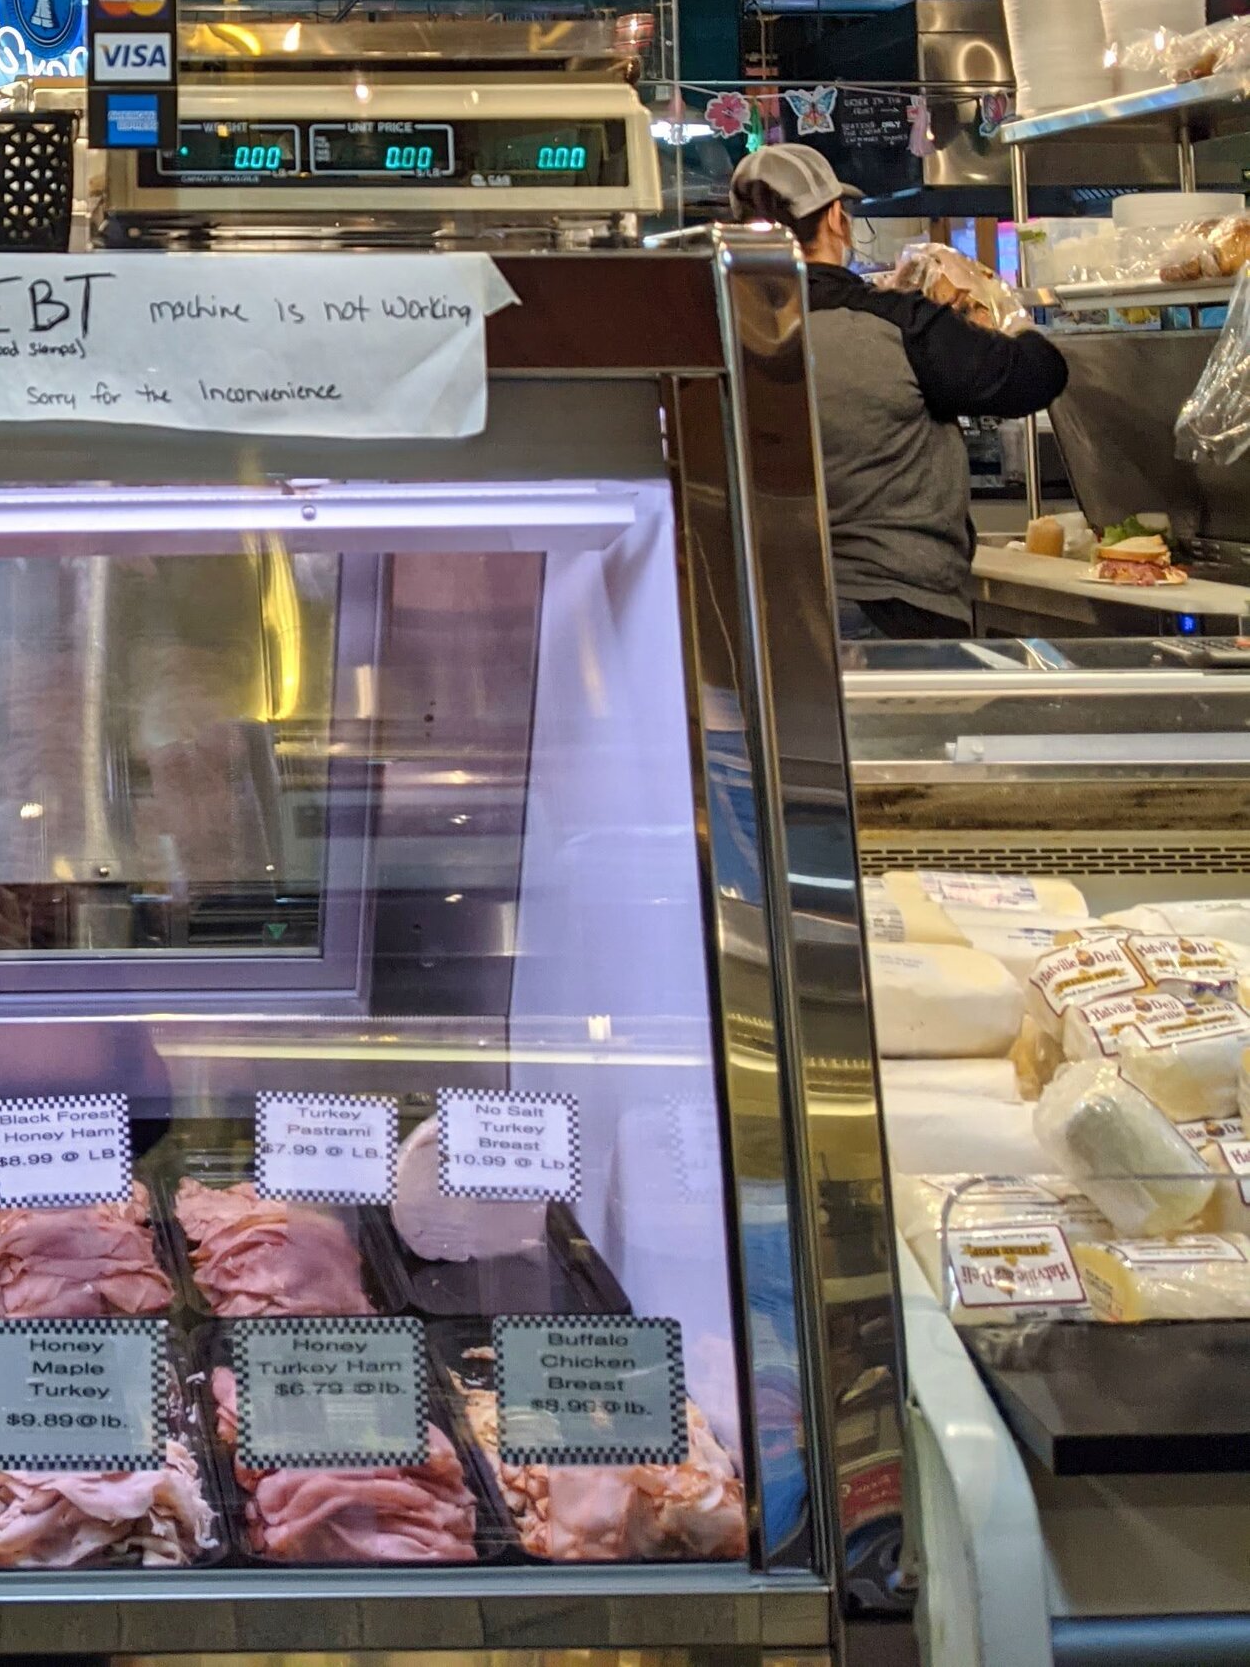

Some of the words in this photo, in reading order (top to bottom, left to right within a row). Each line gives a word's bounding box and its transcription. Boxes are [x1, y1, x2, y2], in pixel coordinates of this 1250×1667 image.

[101, 45, 168, 69] VISA
[377, 122, 414, 133] PRICE
[148, 296, 250, 326] machine
[274, 296, 305, 323] is
[324, 296, 370, 323] not
[26, 386, 77, 410] Sorry
[89, 382, 122, 406] for
[134, 385, 173, 406] the
[1150, 998, 1180, 1011] Deli
[0, 1112, 51, 1126] Black
[56, 1108, 118, 1122] Forest
[296, 1107, 362, 1122] Turkey
[474, 1103, 502, 1117] No
[507, 1103, 545, 1118] Salt
[3, 1128, 64, 1143] Honey
[70, 1127, 116, 1139] Ham
[286, 1123, 372, 1138] Pastrami
[481, 1121, 546, 1136] Turkey
[324, 1145, 343, 1157] @
[478, 1137, 541, 1152] Breast
[61, 1151, 80, 1163] @
[88, 1148, 117, 1160] LB
[513, 1157, 533, 1168] @
[28, 1338, 105, 1354] Honey
[291, 1338, 369, 1353] Honey
[547, 1332, 630, 1347] Buffalo
[32, 1361, 106, 1377] Maple
[257, 1360, 339, 1375] Turkey
[346, 1360, 403, 1373] Ham
[540, 1355, 637, 1369] Chicken
[29, 1383, 111, 1398] Turkey
[548, 1376, 625, 1392] Breast
